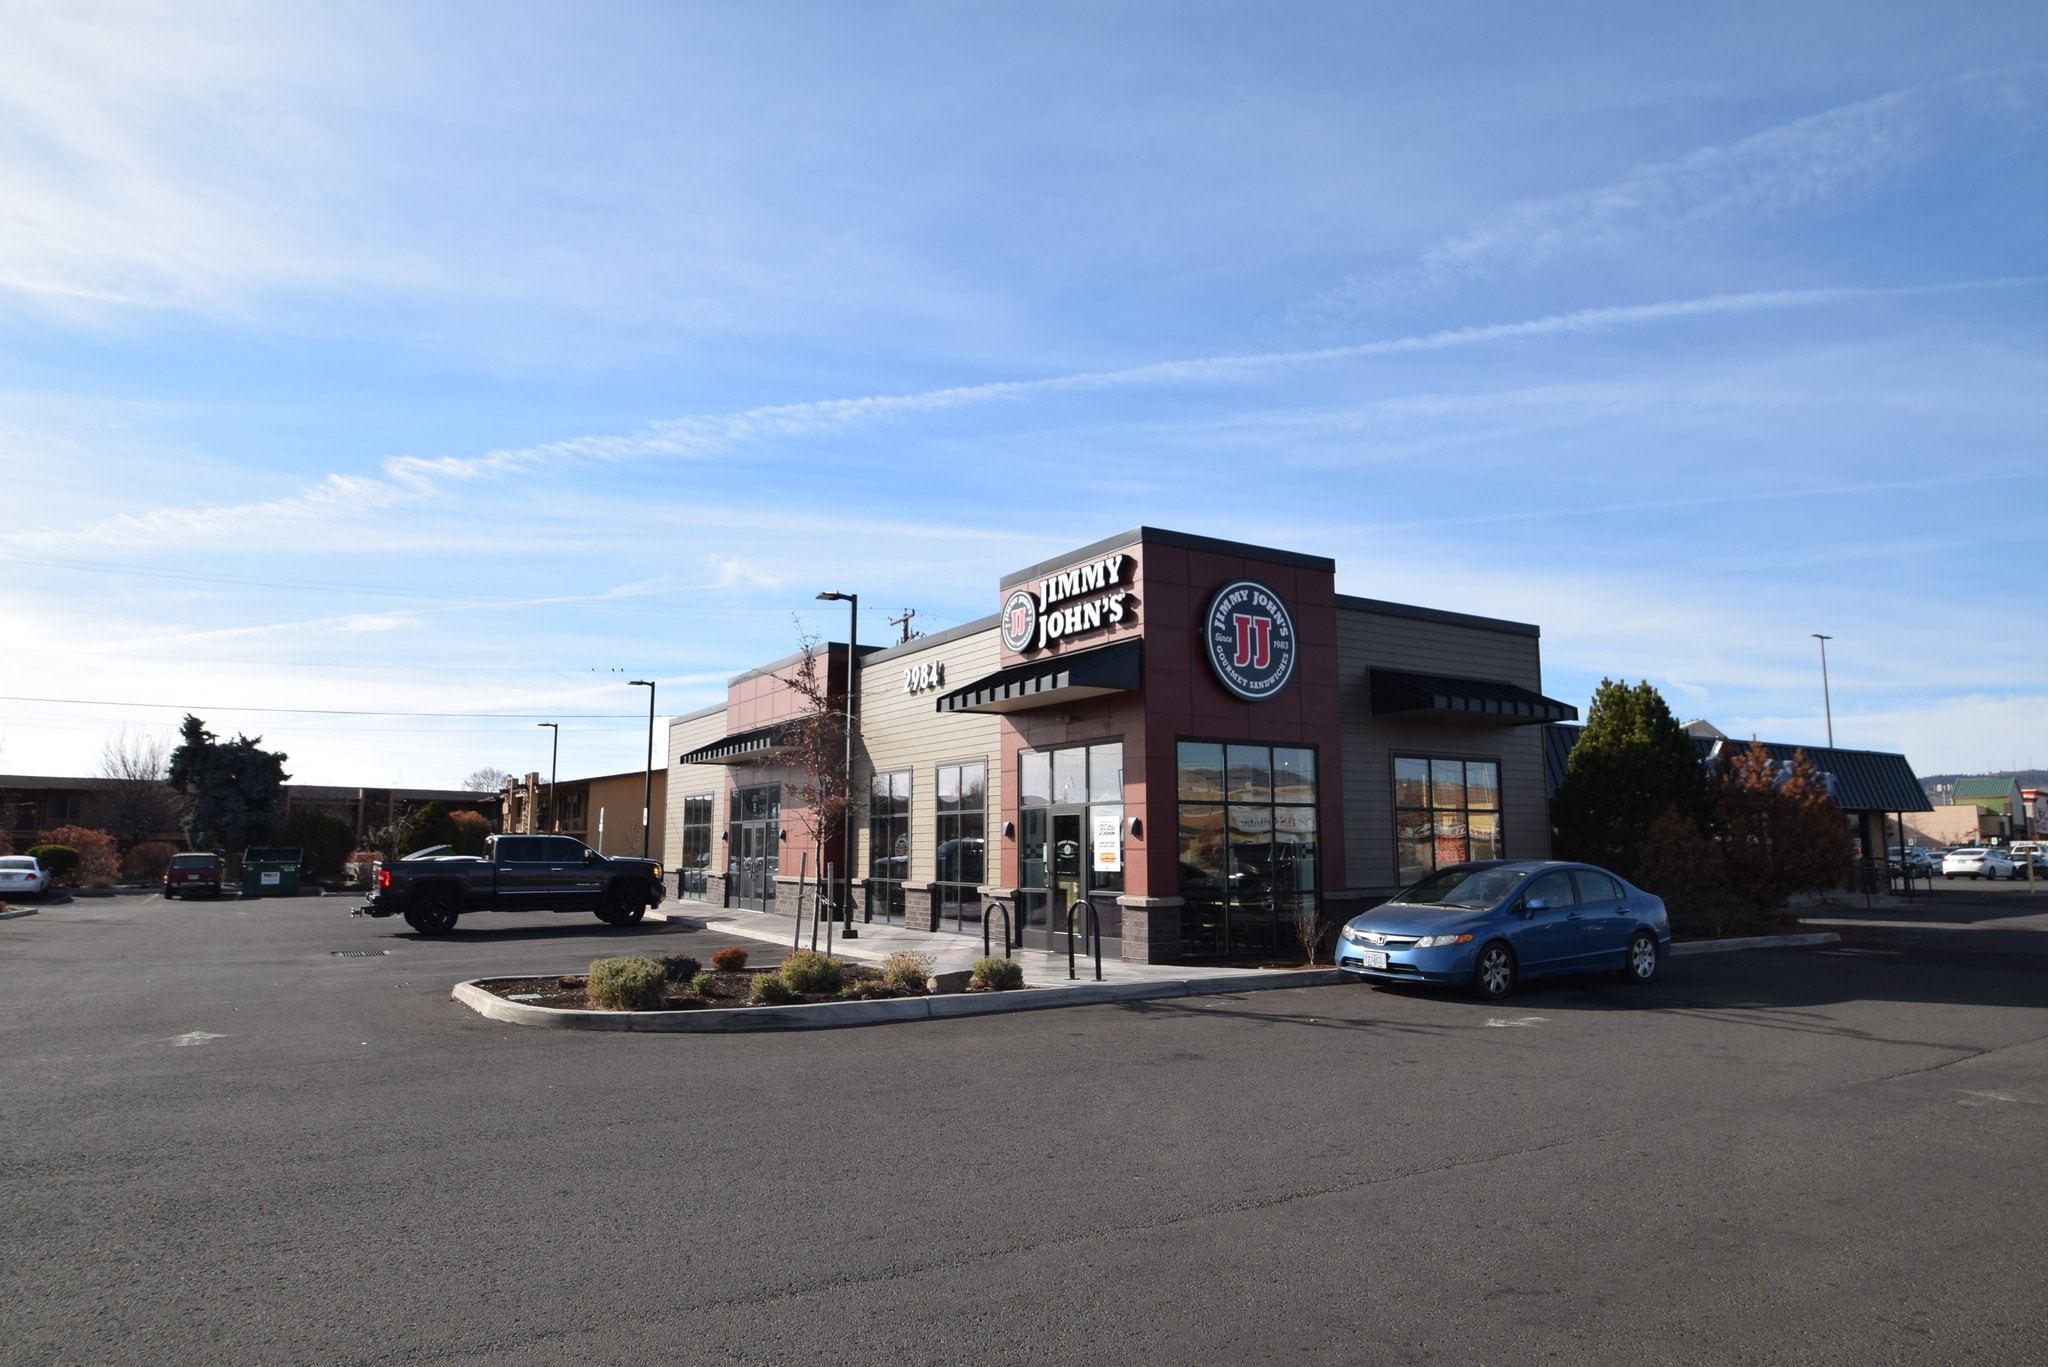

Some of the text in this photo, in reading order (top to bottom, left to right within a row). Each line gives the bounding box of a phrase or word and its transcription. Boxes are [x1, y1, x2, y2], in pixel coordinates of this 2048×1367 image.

[1039, 554, 1123, 613] JIMMY
[1010, 607, 1026, 638] JJ
[1038, 594, 1124, 648] JOHN'S
[1214, 589, 1289, 637] JIMMY JOHN'S
[1214, 632, 1233, 643] Since
[1232, 613, 1272, 669] JJ
[1273, 640, 1289, 650] 1983
[903, 659, 938, 693] 2984
[1216, 645, 1289, 689] GOURMET SANDWICHES
